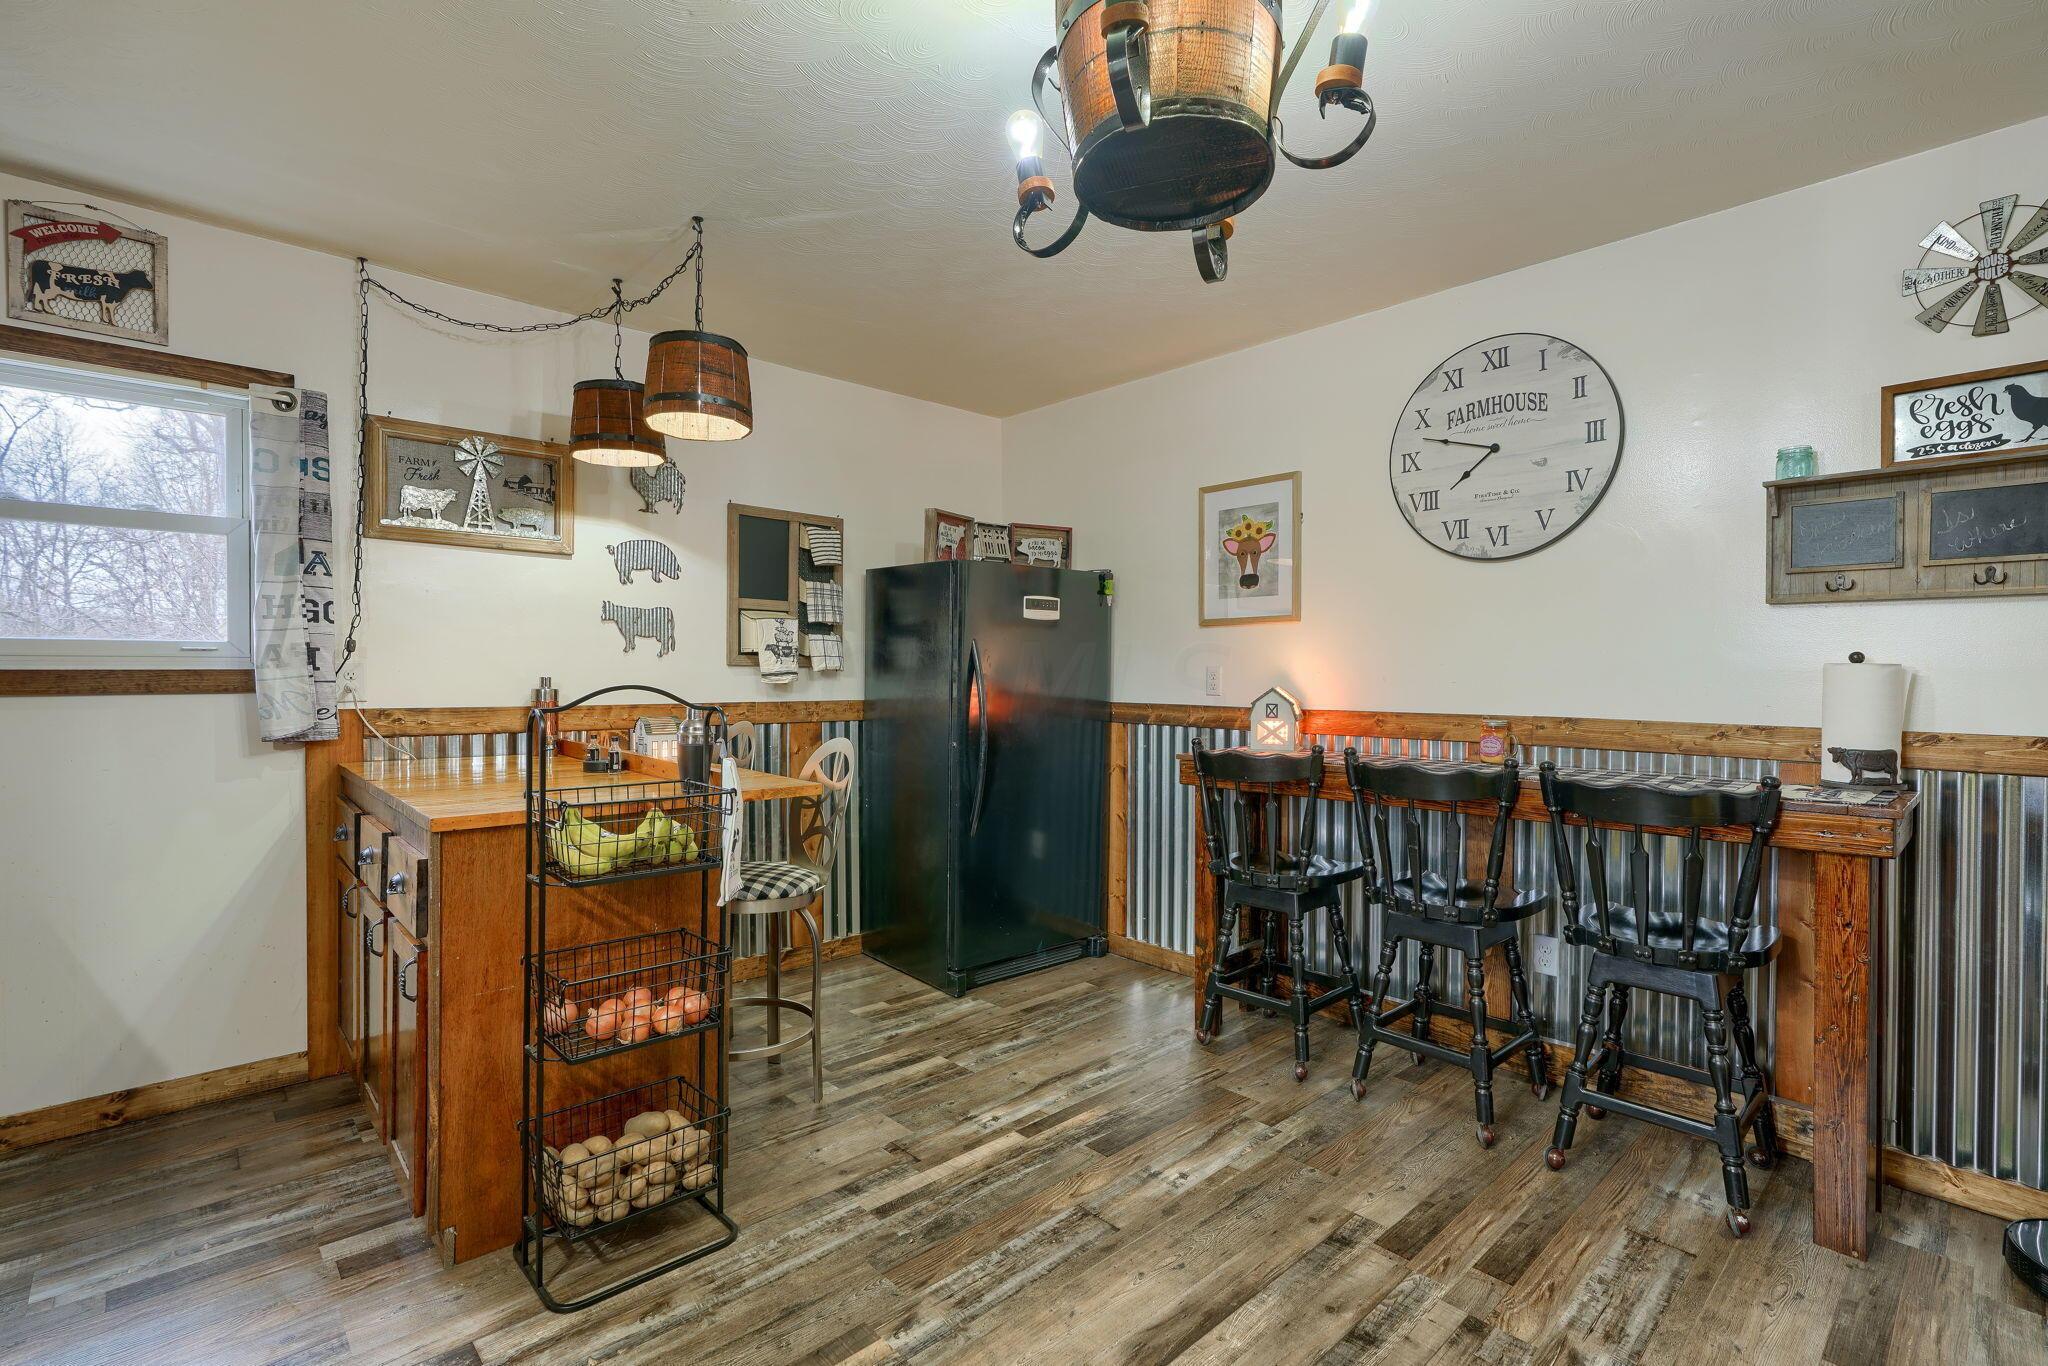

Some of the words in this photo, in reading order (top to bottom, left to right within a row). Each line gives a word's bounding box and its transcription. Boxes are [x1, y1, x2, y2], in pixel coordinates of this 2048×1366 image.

[28, 224, 98, 238] WELCOME
[1978, 253, 2009, 269] HOUSE
[1978, 263, 2009, 280] RULES
[47, 269, 120, 288] FRESH
[1481, 346, 1510, 373] XII
[1538, 348, 1548, 371] I
[1442, 367, 1464, 393] XI
[1572, 375, 1588, 399] II
[1447, 392, 1548, 430] FARMHOUSE
[1909, 386, 2005, 425] fresh
[1414, 408, 1431, 430] X
[1920, 413, 1995, 441] eggs
[1584, 418, 1607, 444] III
[1958, 439, 2001, 452] dozen
[398, 455, 431, 467] FARM
[1401, 451, 1422, 474] IX
[403, 467, 441, 481] Fresh
[1565, 468, 1592, 493] IV
[1408, 490, 1440, 513] VIII
[1441, 519, 1470, 541] VII
[1535, 508, 1556, 531] V
[1485, 525, 1510, 547] VI
